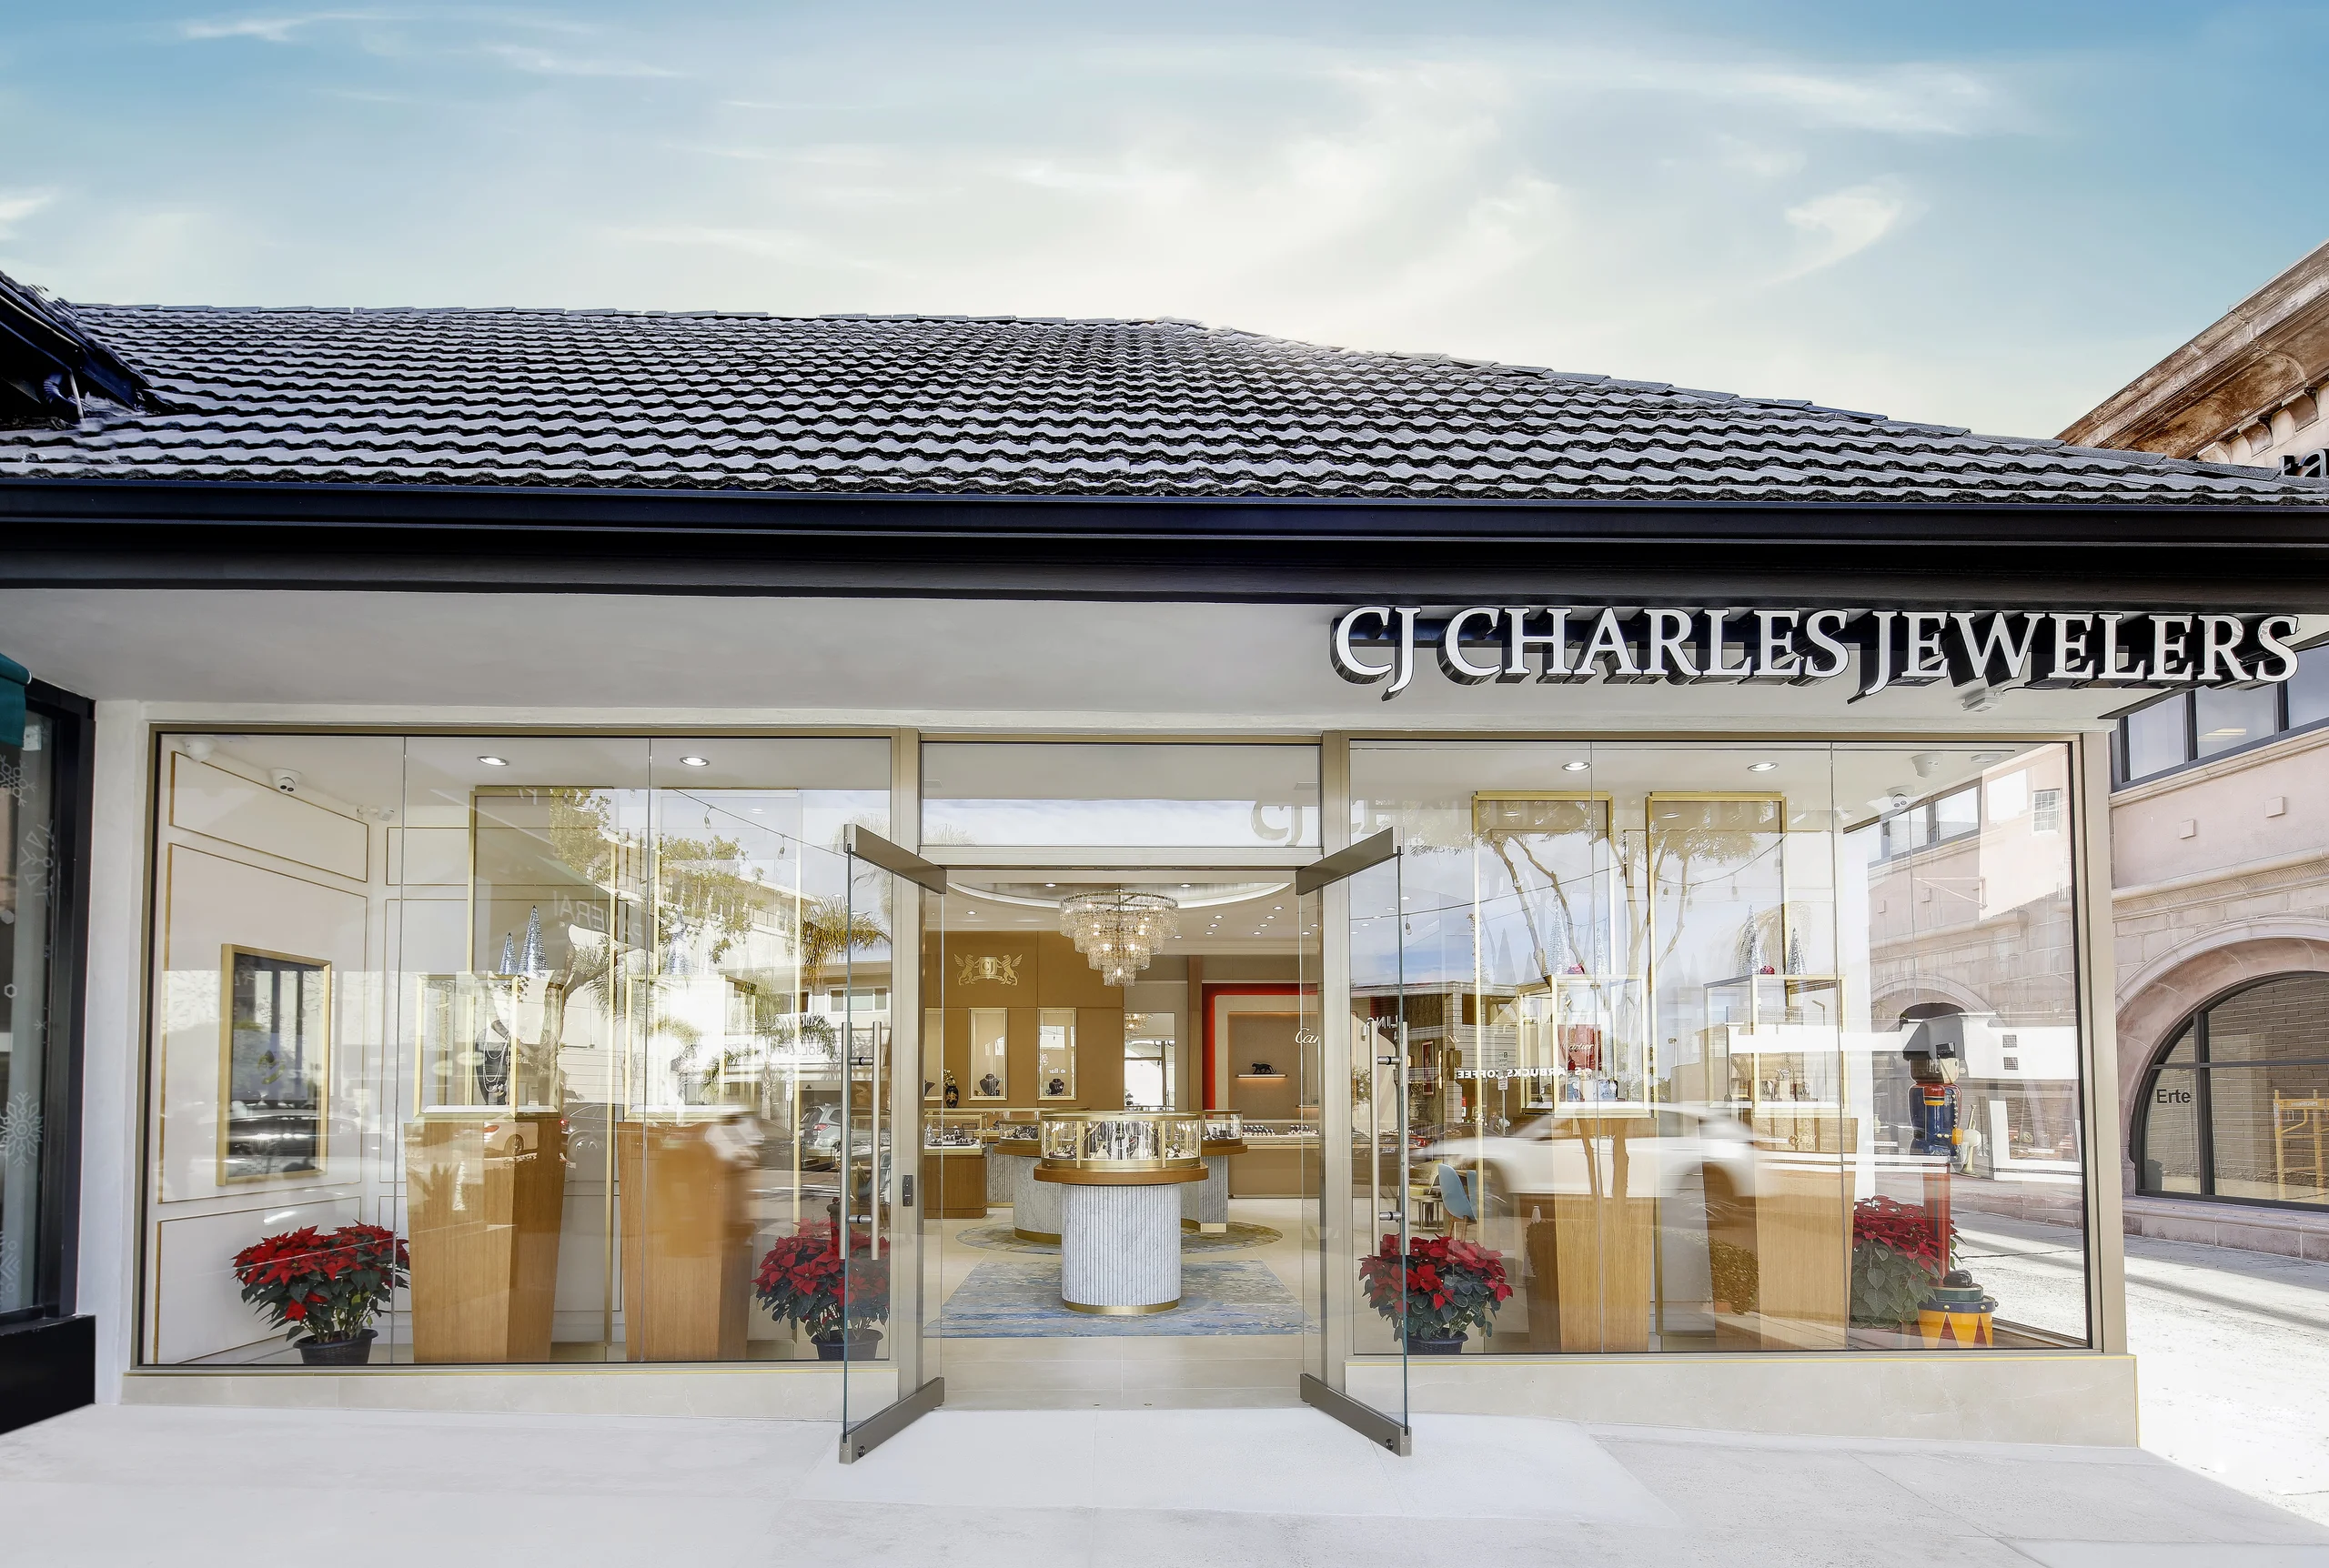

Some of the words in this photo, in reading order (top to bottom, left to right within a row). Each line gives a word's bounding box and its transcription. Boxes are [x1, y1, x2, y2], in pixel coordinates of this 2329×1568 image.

[1334, 605, 1421, 695] CJ
[1439, 605, 1850, 679] CHARLES
[1863, 609, 2301, 697] JEWELERS
[982, 960, 994, 974] CJ
[2156, 1089, 2191, 1103] Erte
